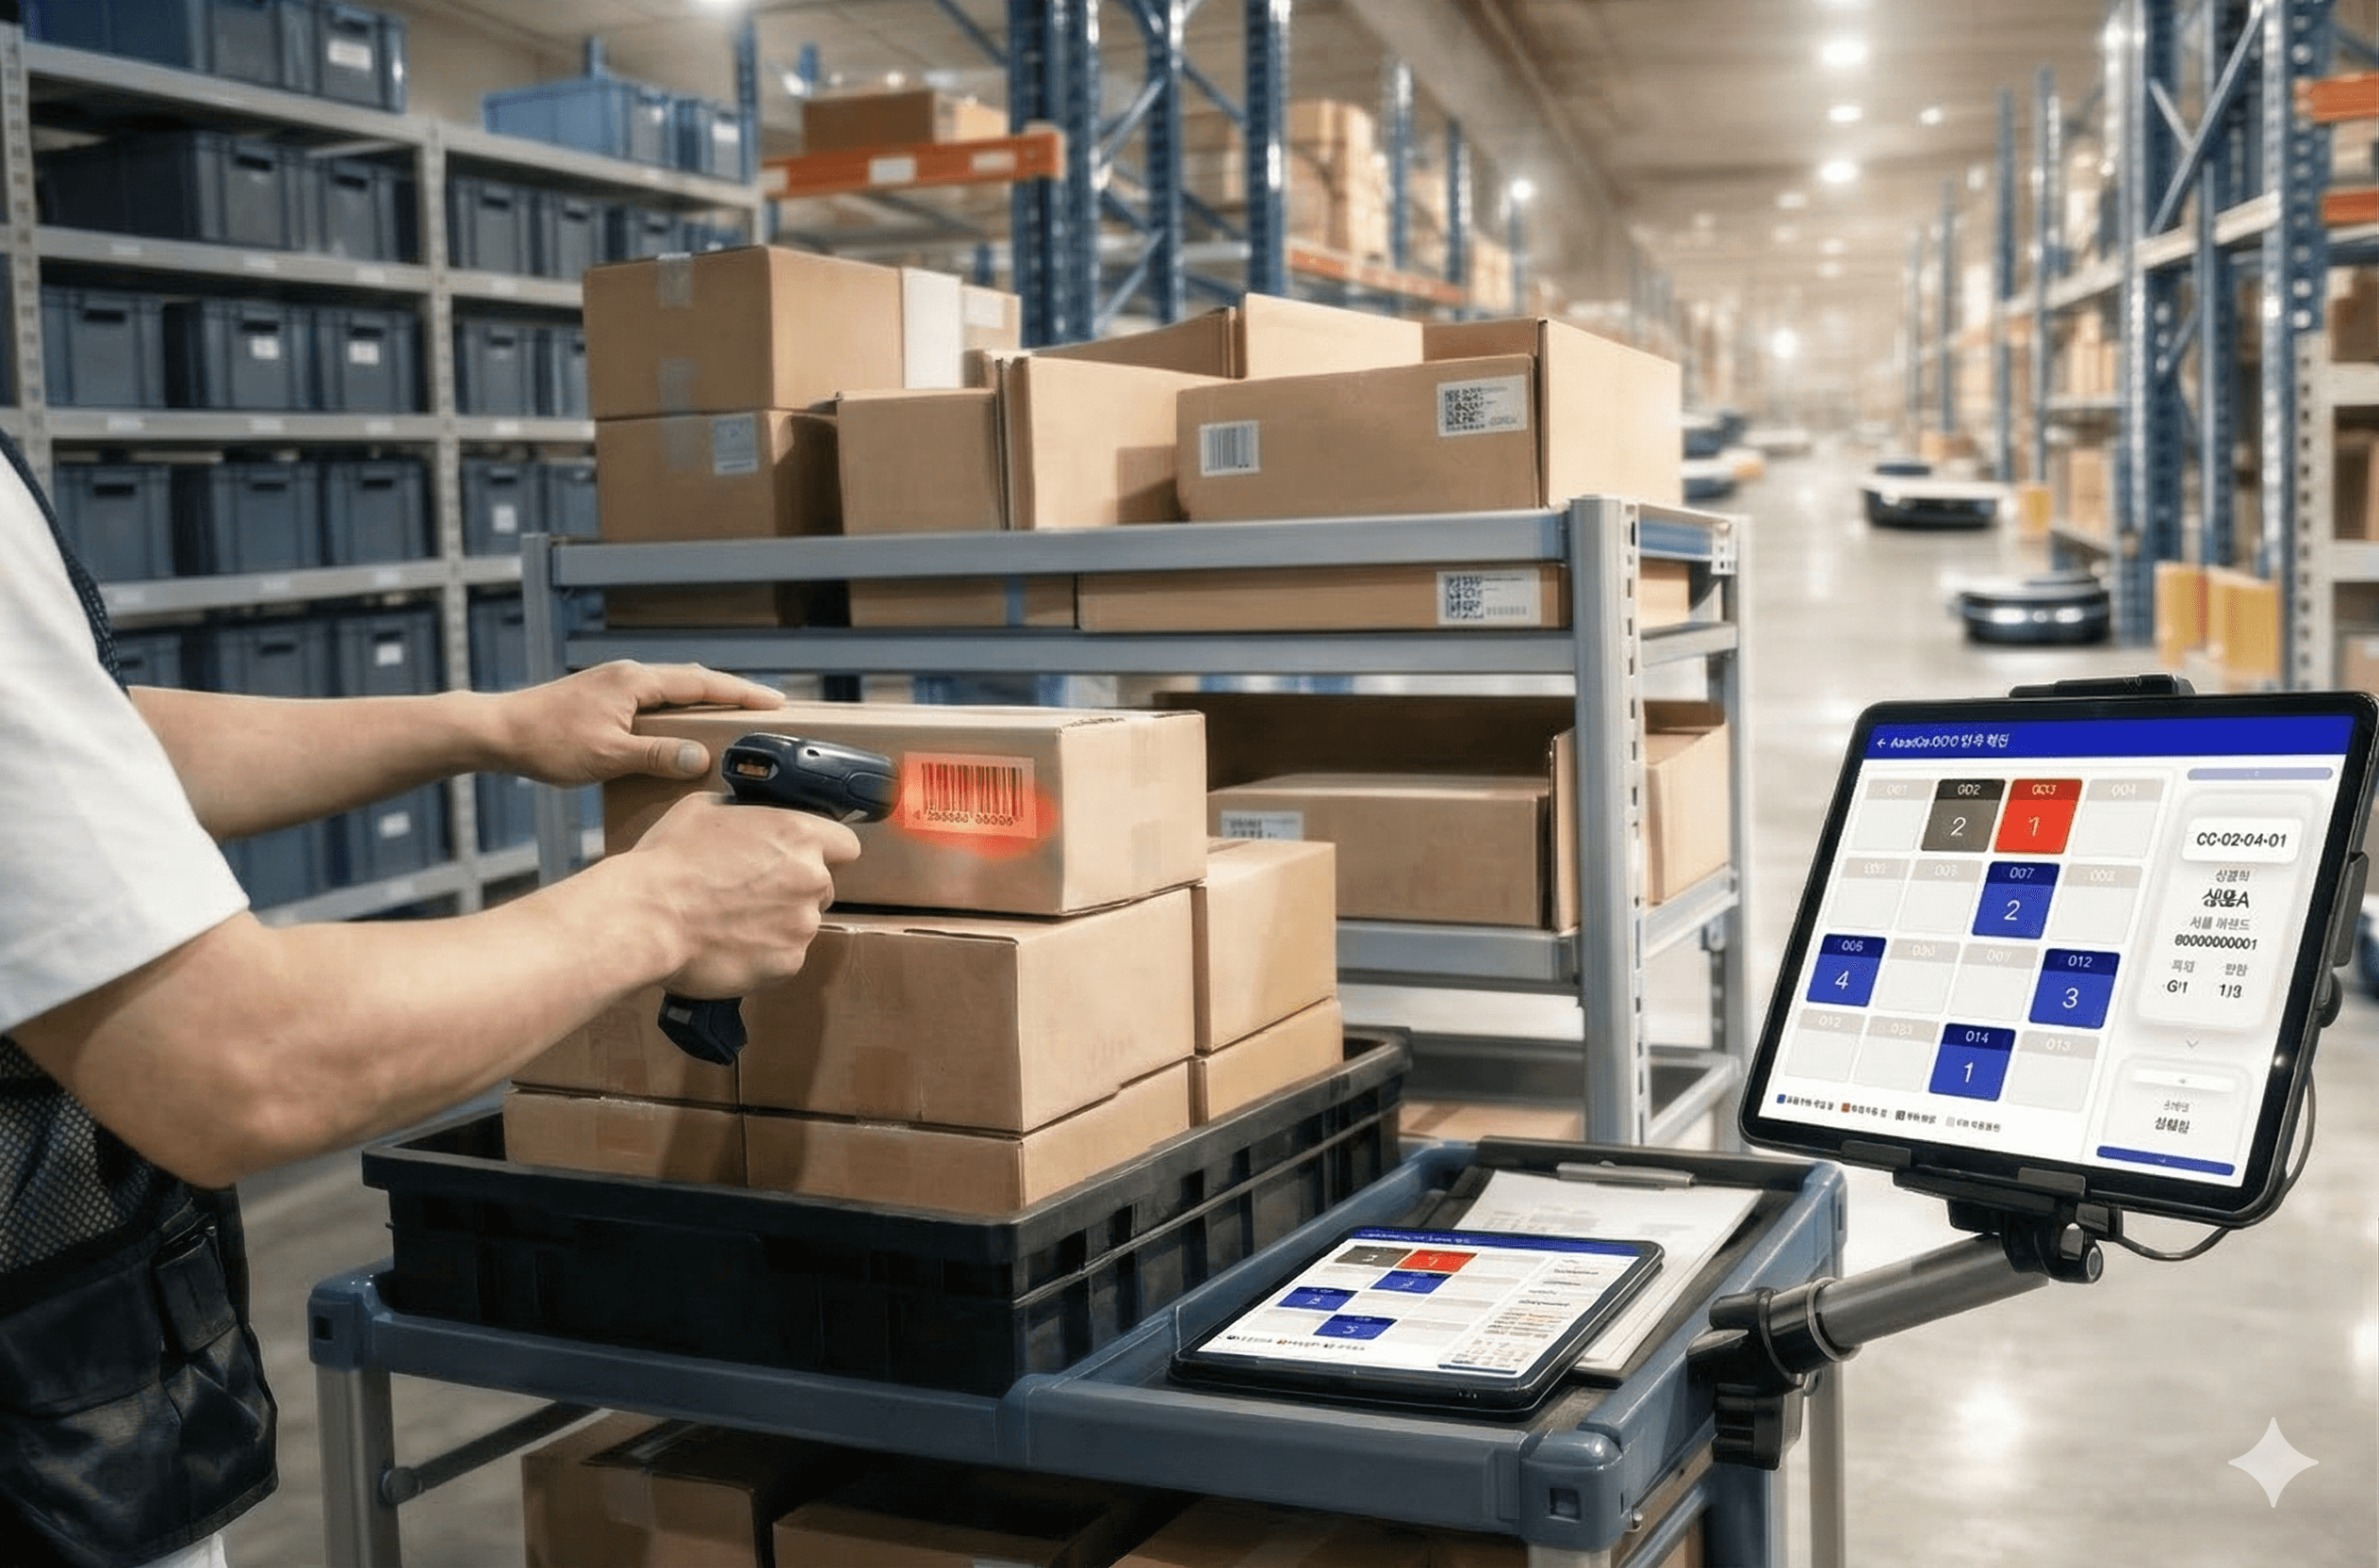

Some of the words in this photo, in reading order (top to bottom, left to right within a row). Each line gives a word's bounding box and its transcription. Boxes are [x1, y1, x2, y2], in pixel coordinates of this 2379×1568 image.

[1950, 816, 1967, 837] 2
[2027, 816, 2041, 838] 1
[2010, 867, 2035, 879] 007
[2004, 900, 2022, 922] 2
[2068, 955, 2092, 969] 012
[1834, 970, 1848, 990] 4
[2062, 988, 2079, 1008] 3
[1965, 1030, 1989, 1044] 014
[1962, 1062, 1974, 1084] 1
